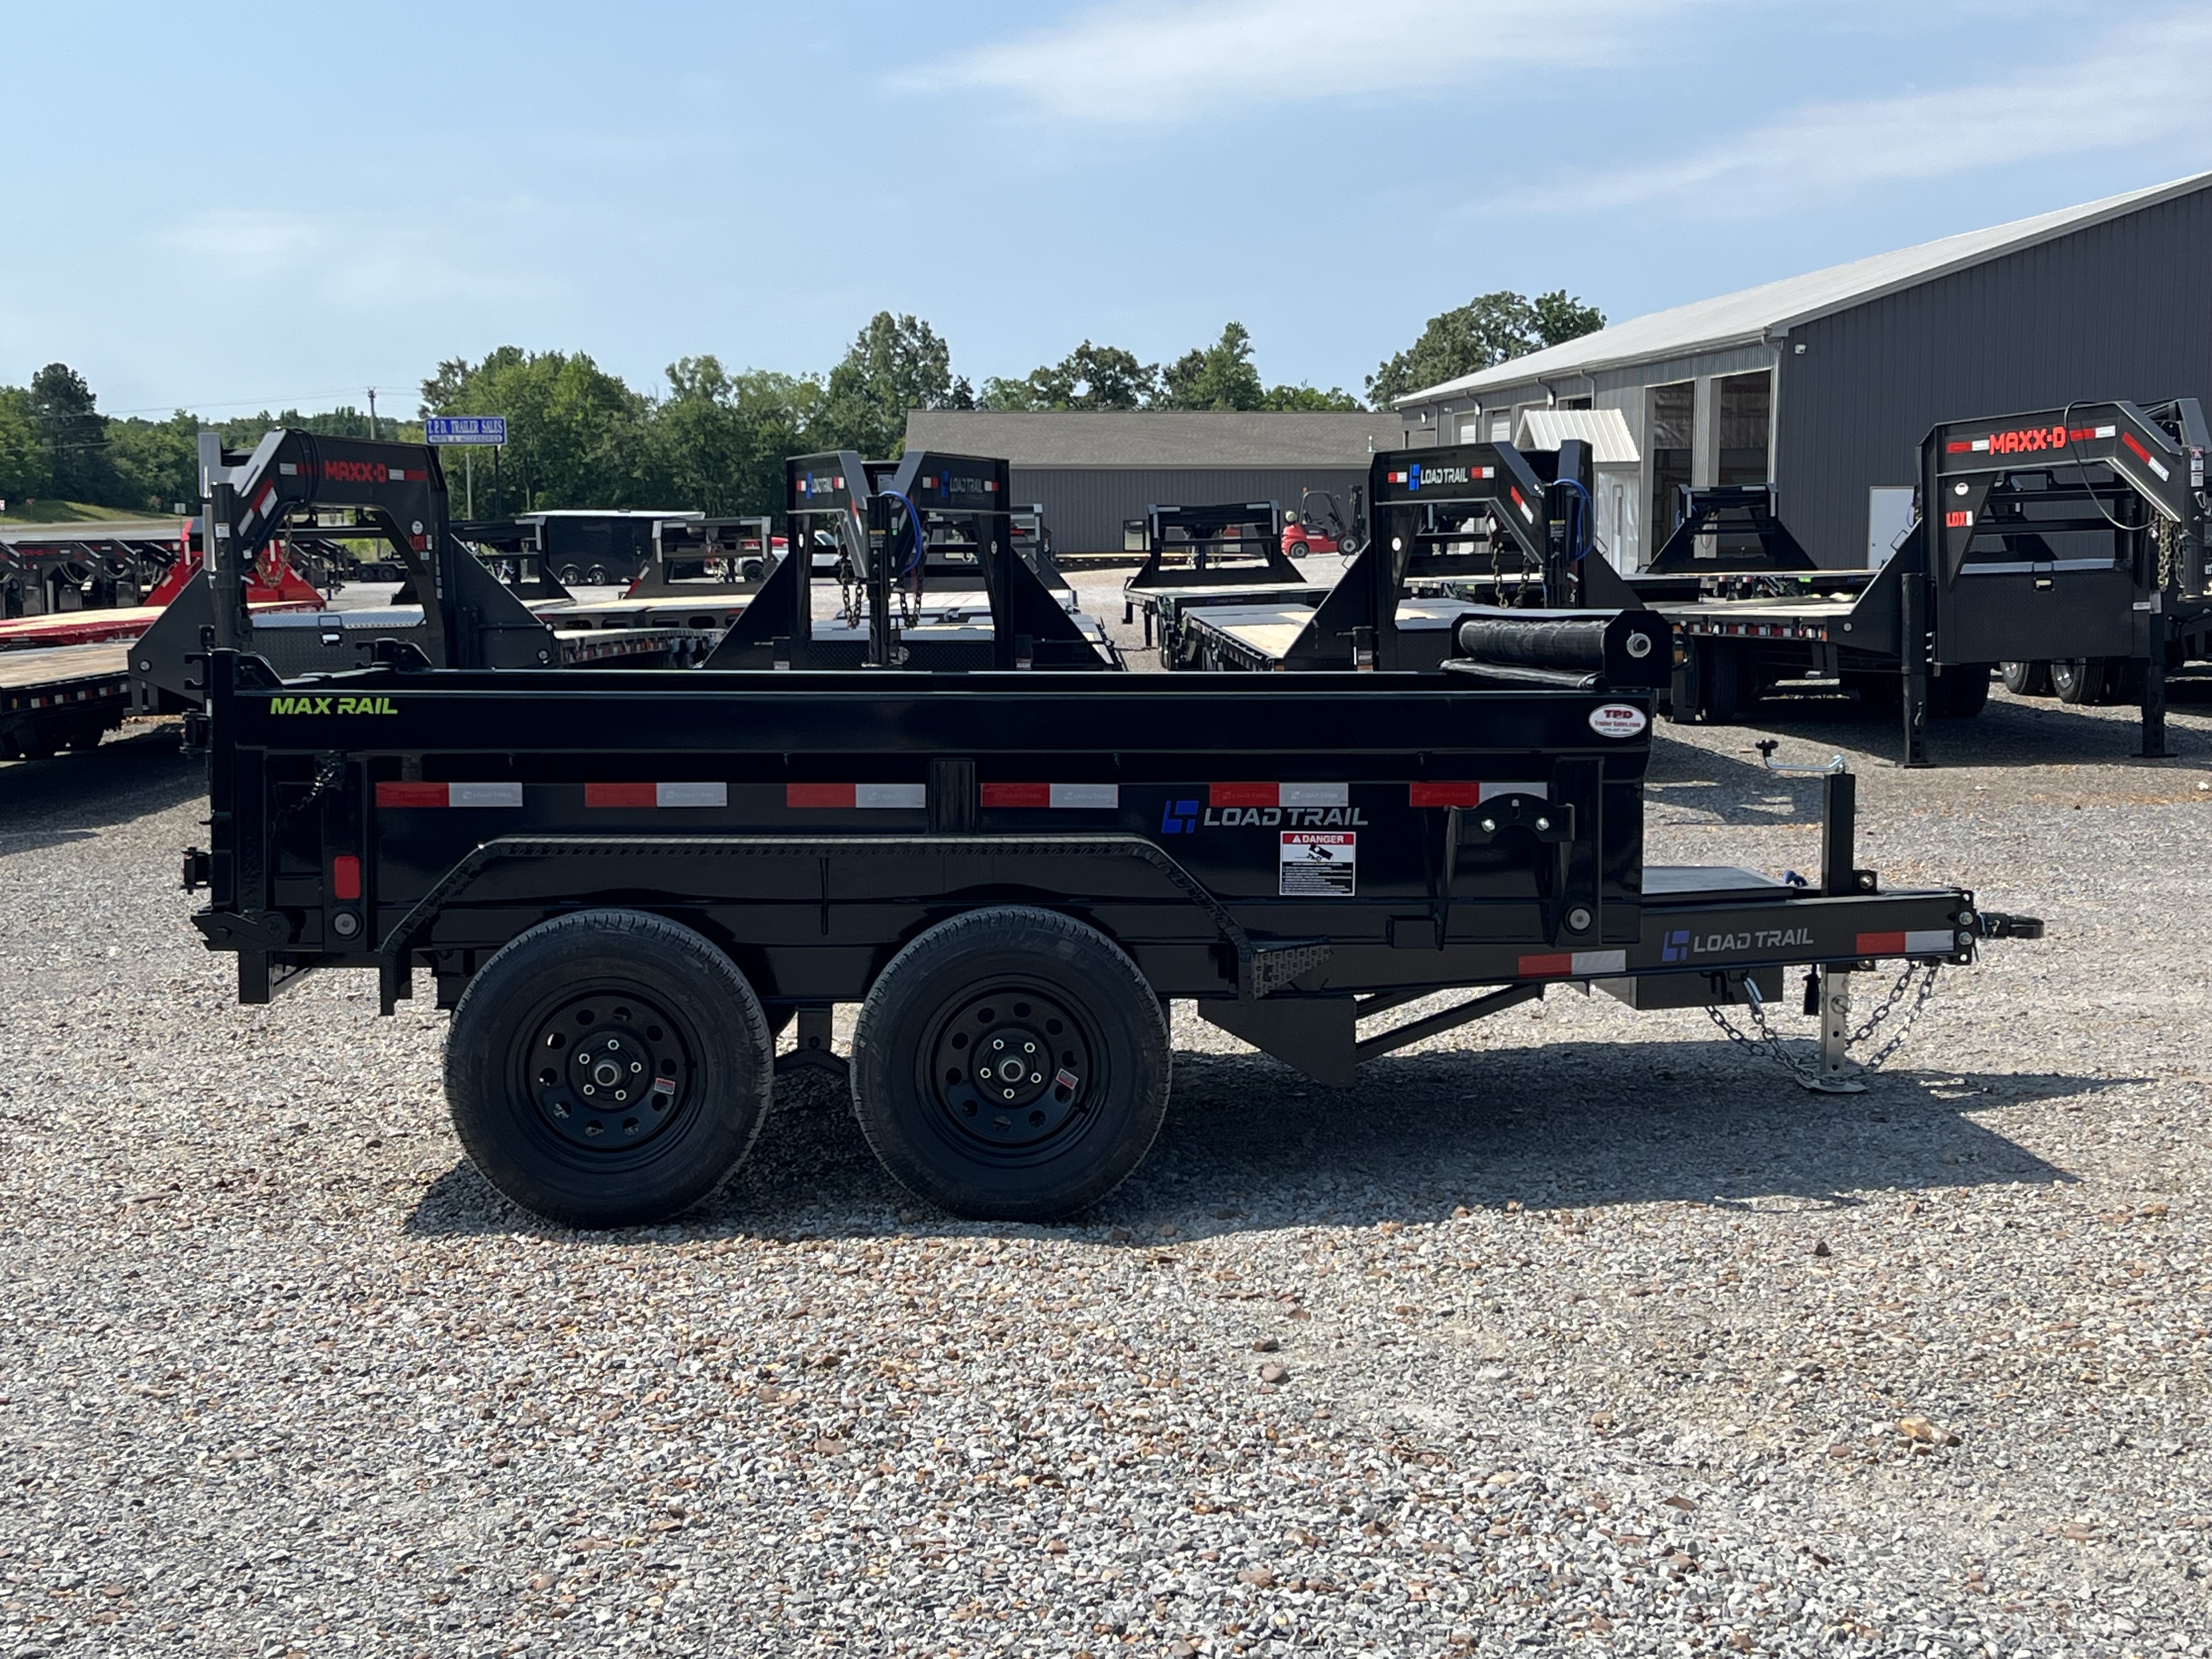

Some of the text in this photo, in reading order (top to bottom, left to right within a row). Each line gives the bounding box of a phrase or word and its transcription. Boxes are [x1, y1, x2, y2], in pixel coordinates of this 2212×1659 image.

[450, 420, 479, 434] TRAILER
[481, 420, 503, 434] SALES
[1420, 467, 1469, 484] LOAD TRAIL
[270, 697, 398, 714] MAX RAIL
[1604, 709, 1633, 719] TPD
[1204, 808, 1368, 826] LOAD TRAIL
[1302, 834, 1344, 844] DANGER
[1694, 928, 1814, 953] LOAD TRAIL
